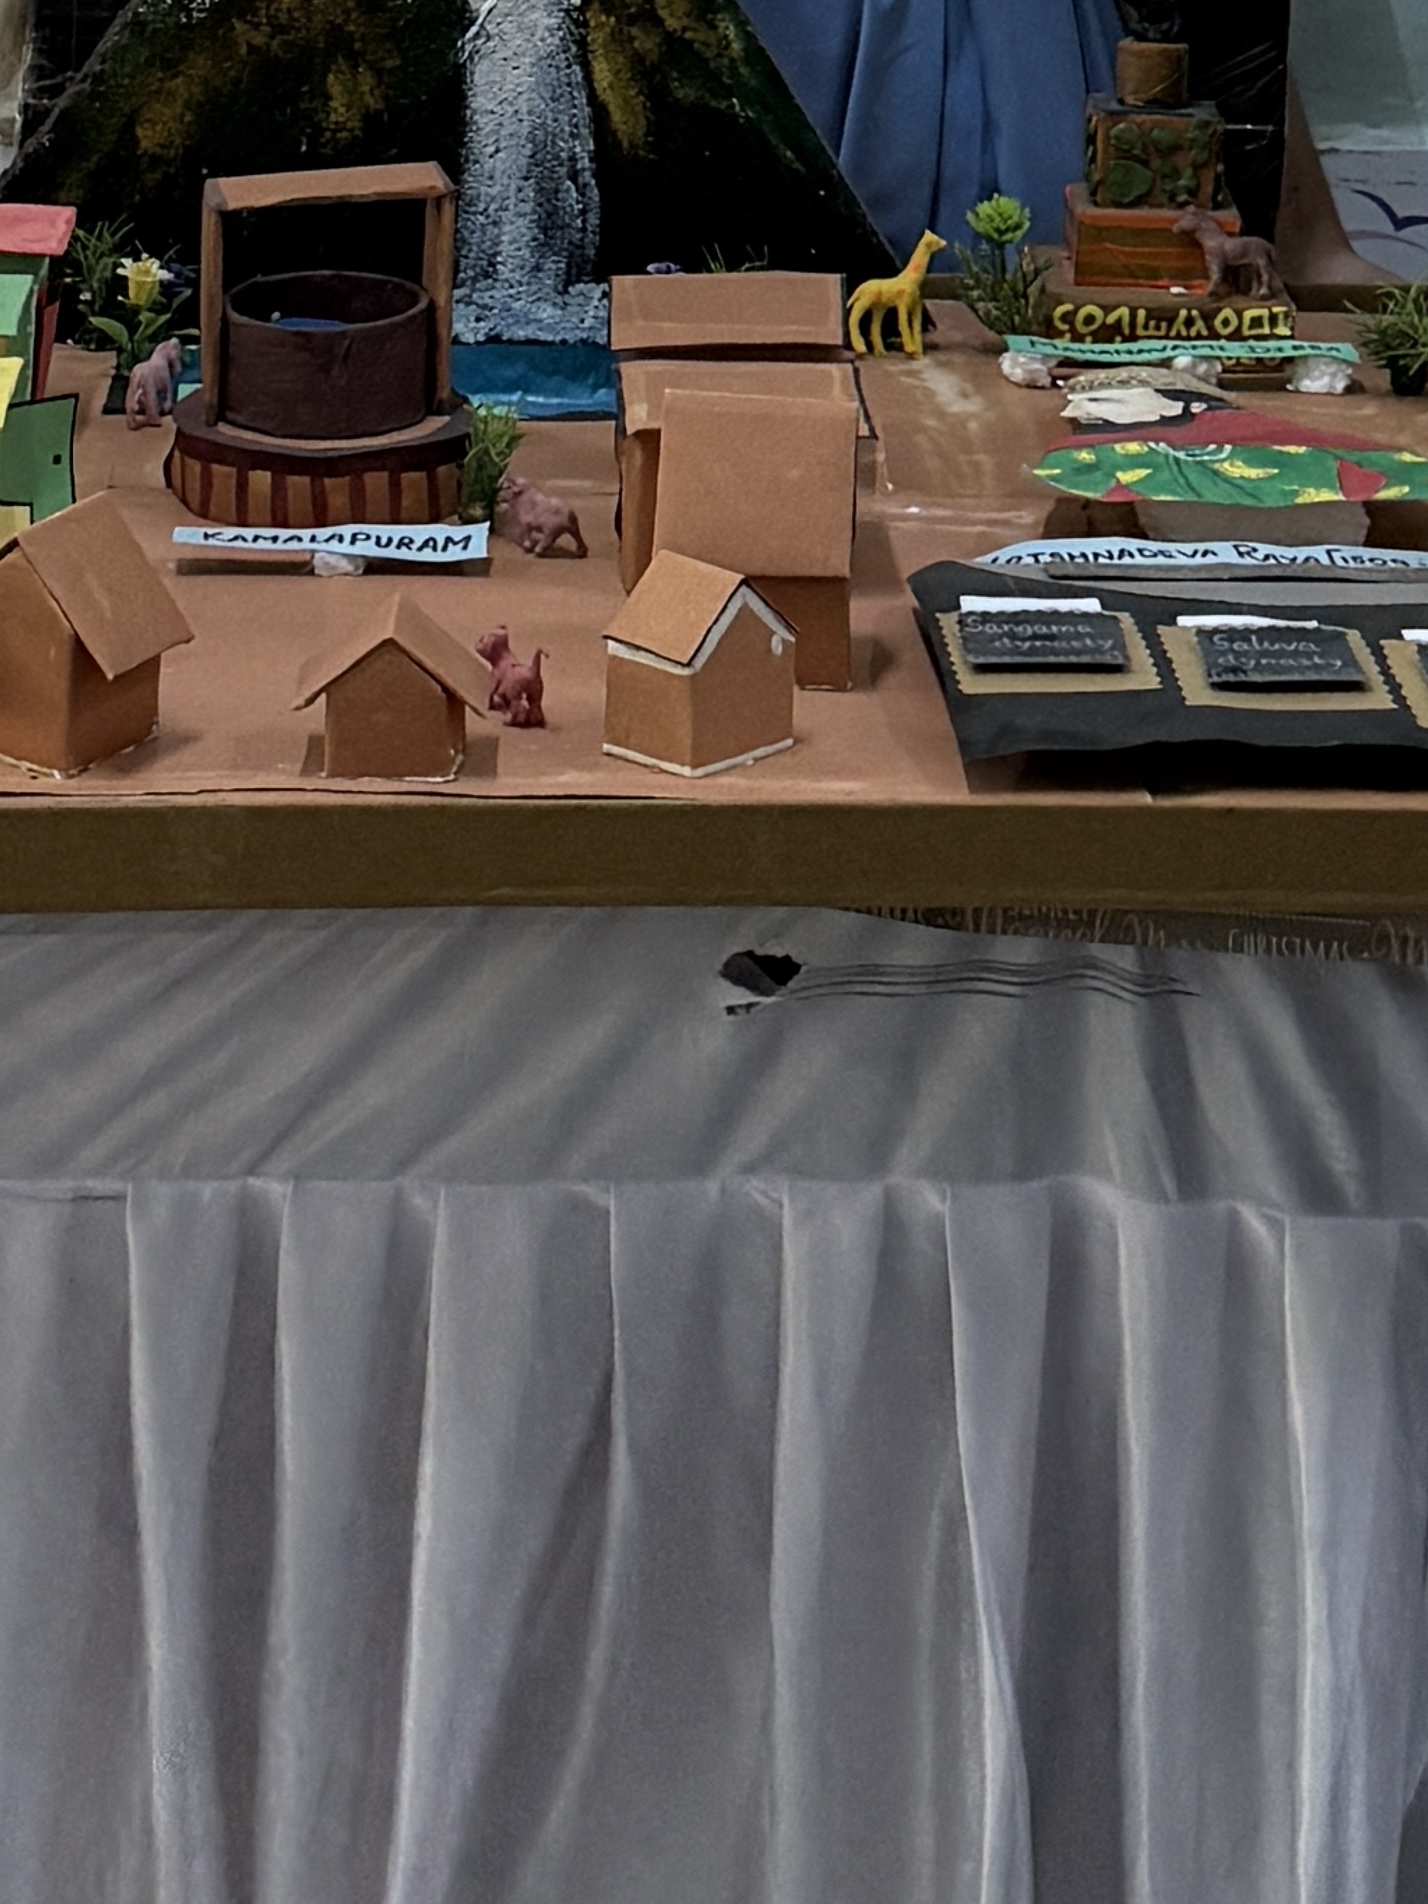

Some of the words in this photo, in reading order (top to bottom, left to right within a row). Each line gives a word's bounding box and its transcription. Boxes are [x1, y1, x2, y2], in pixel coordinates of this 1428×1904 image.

[202, 529, 475, 554] KAMALAPURAM
[963, 615, 1094, 641] Sangama
[1211, 633, 1321, 654] Saluva
